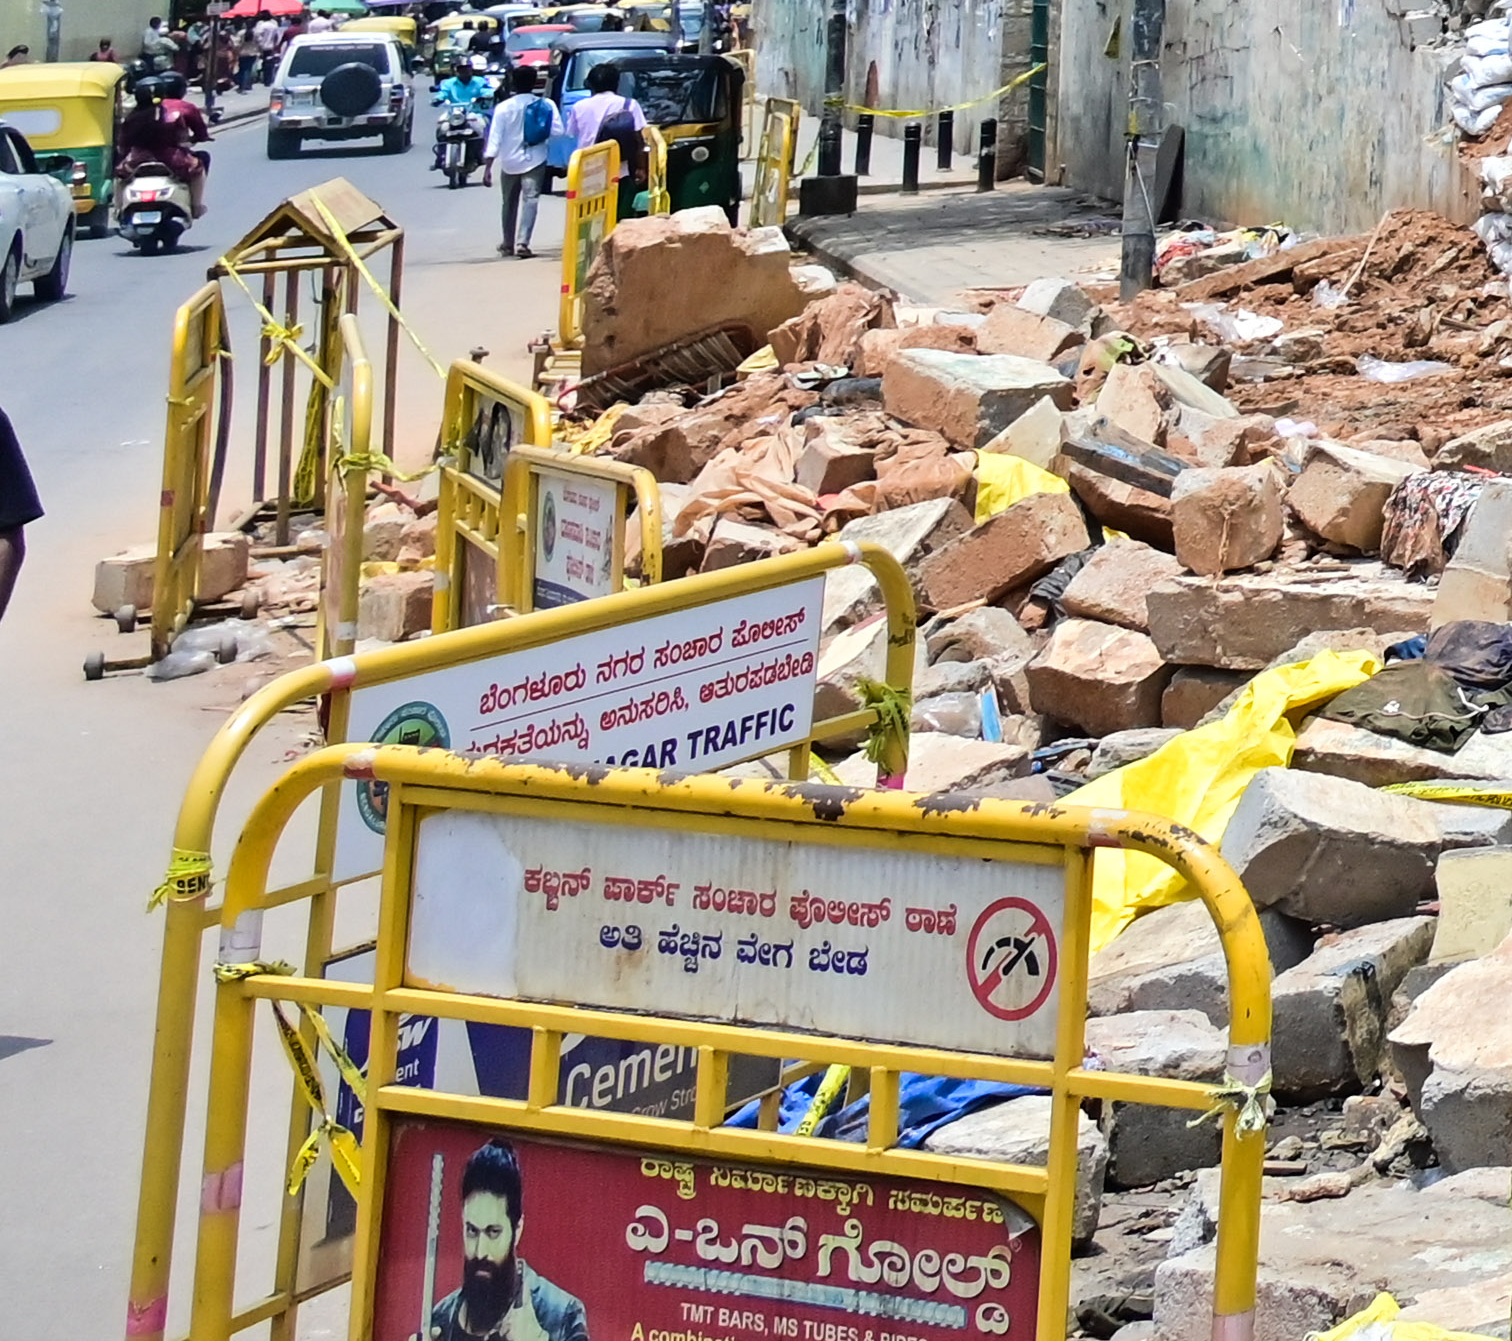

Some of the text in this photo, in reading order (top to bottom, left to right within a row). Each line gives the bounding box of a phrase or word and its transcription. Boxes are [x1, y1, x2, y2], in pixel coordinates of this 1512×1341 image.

[480, 607, 805, 716] ಬೆಂಗಳೂರು ನಗರ ಸಂಚಾರ ಪೊಲೀಸ್
[687, 703, 796, 760] TRAFFIC
[523, 864, 957, 935] ಕಬ್ಬನ್ ಪಾರ್ಕ್ ಸಂಚಾರ ಪೊಲೀಸ್ ಠಾಣೆ
[599, 923, 870, 977] ಅತಿ ಹೆಚ್ಚಿನ ವೇಗ ಬೇಡ
[566, 1044, 699, 1110] Cemen
[681, 1302, 714, 1325] TMT
[718, 1308, 768, 1337] BARS,
[774, 1316, 798, 1337] MS
[803, 1320, 858, 1341] TUBES
